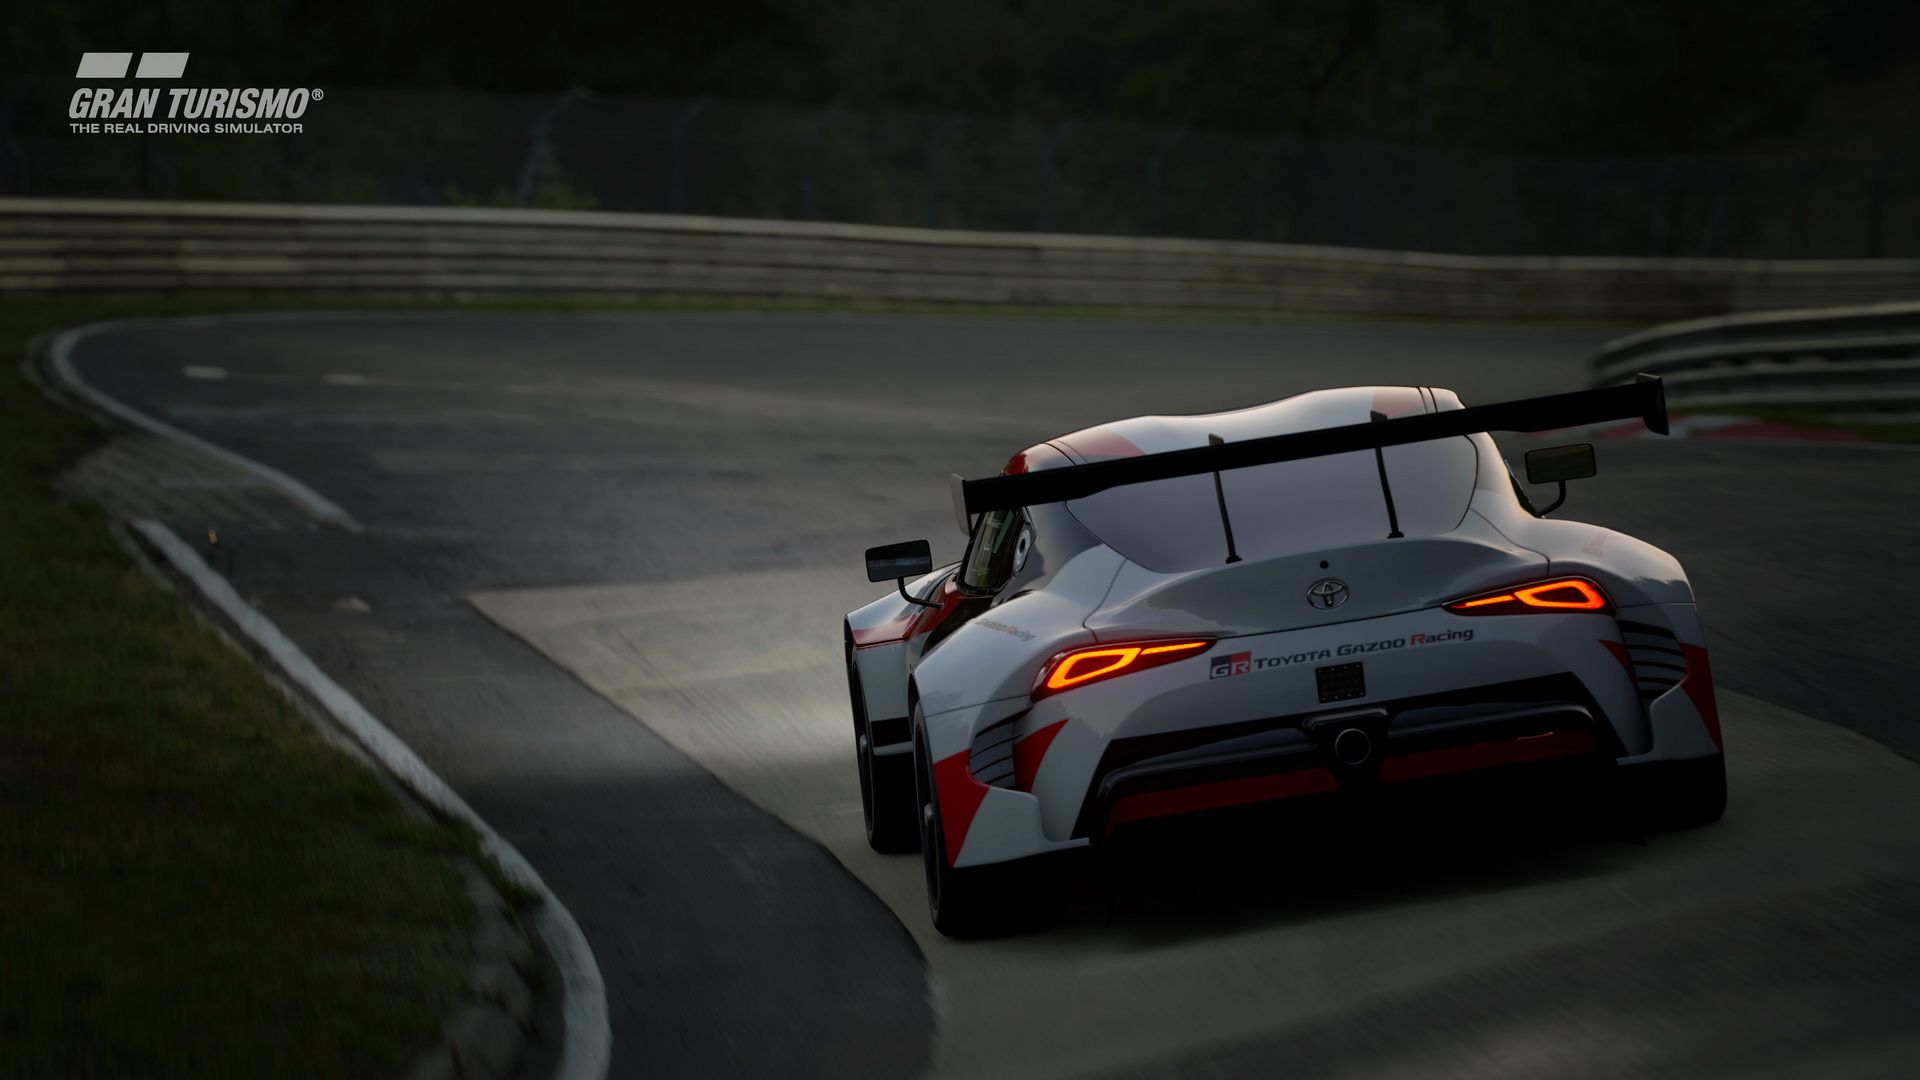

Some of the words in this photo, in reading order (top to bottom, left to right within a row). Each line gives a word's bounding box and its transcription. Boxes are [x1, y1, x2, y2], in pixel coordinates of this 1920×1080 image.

[1253, 649, 1331, 670] TOYOTA
[1336, 637, 1406, 657] GAZOO
[1410, 629, 1474, 647] Racing
[1210, 657, 1250, 679] GR
